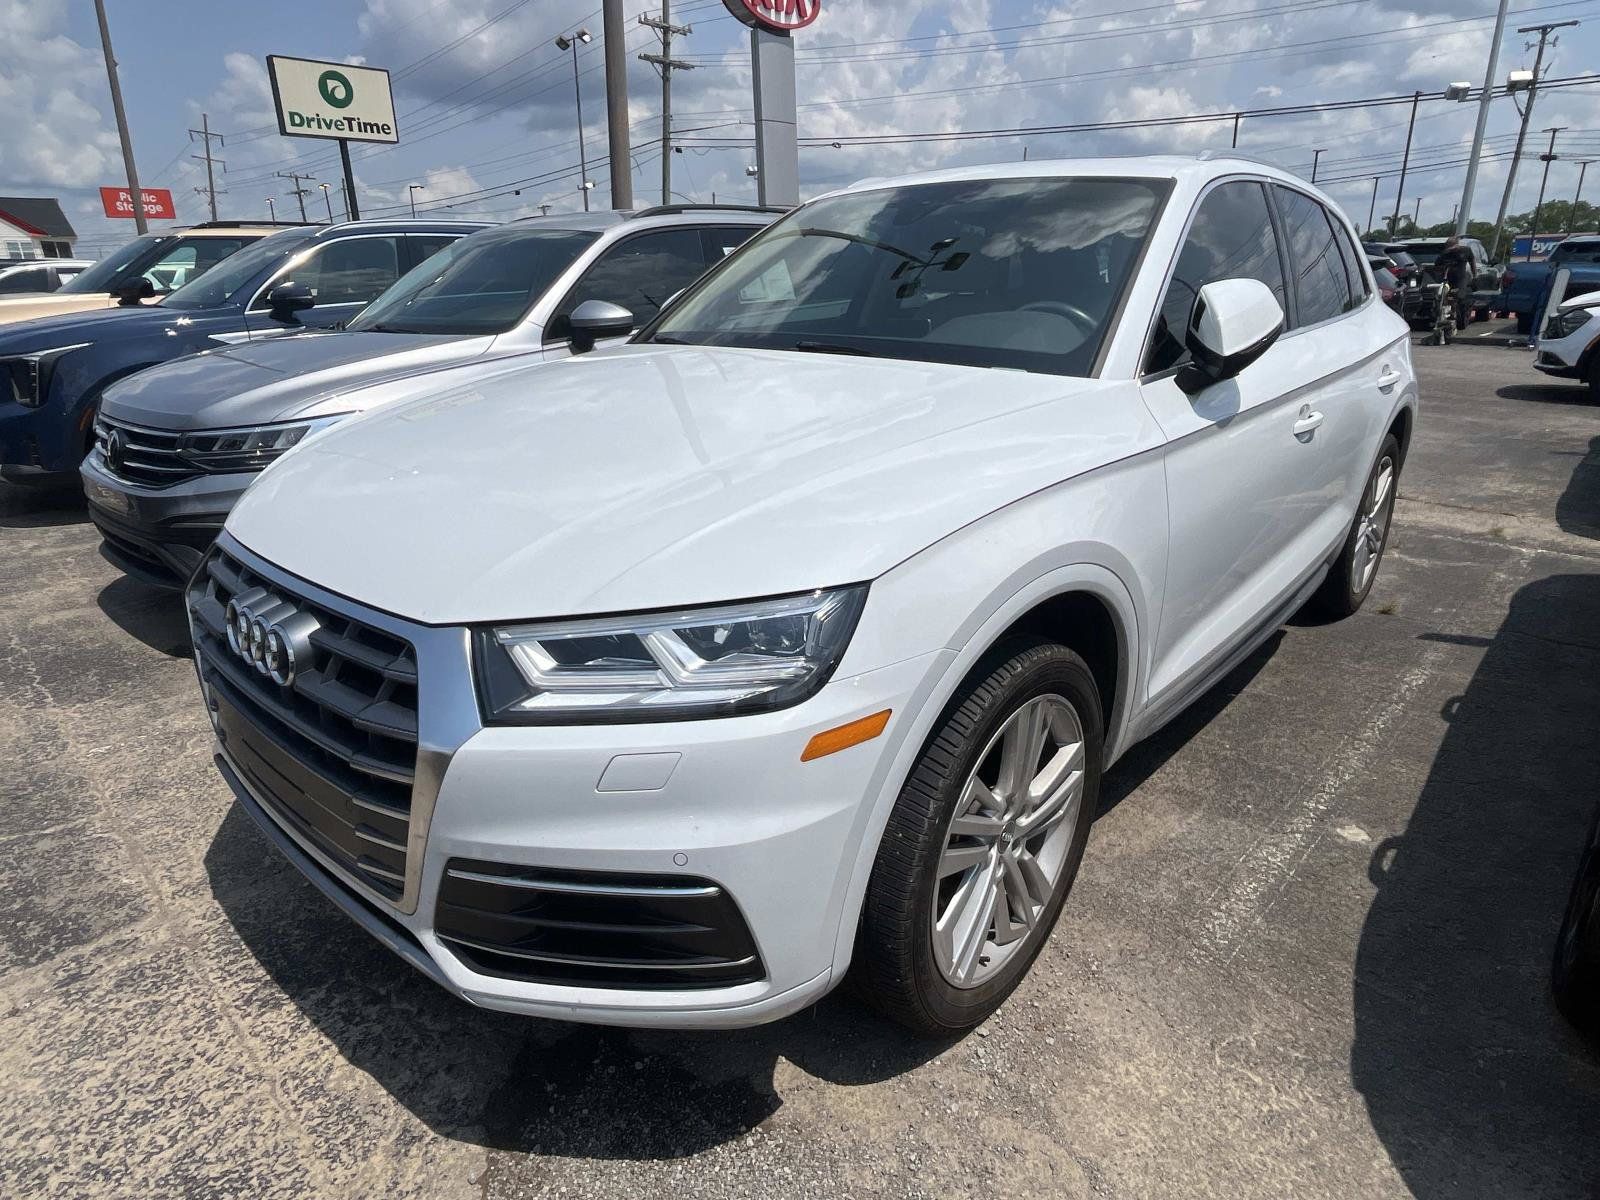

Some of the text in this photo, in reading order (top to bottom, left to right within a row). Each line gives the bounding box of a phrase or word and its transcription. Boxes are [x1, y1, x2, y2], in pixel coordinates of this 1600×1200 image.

[288, 110, 391, 135] DriveTime
[119, 192, 157, 203] Pulic
[116, 201, 164, 214] Stoage
